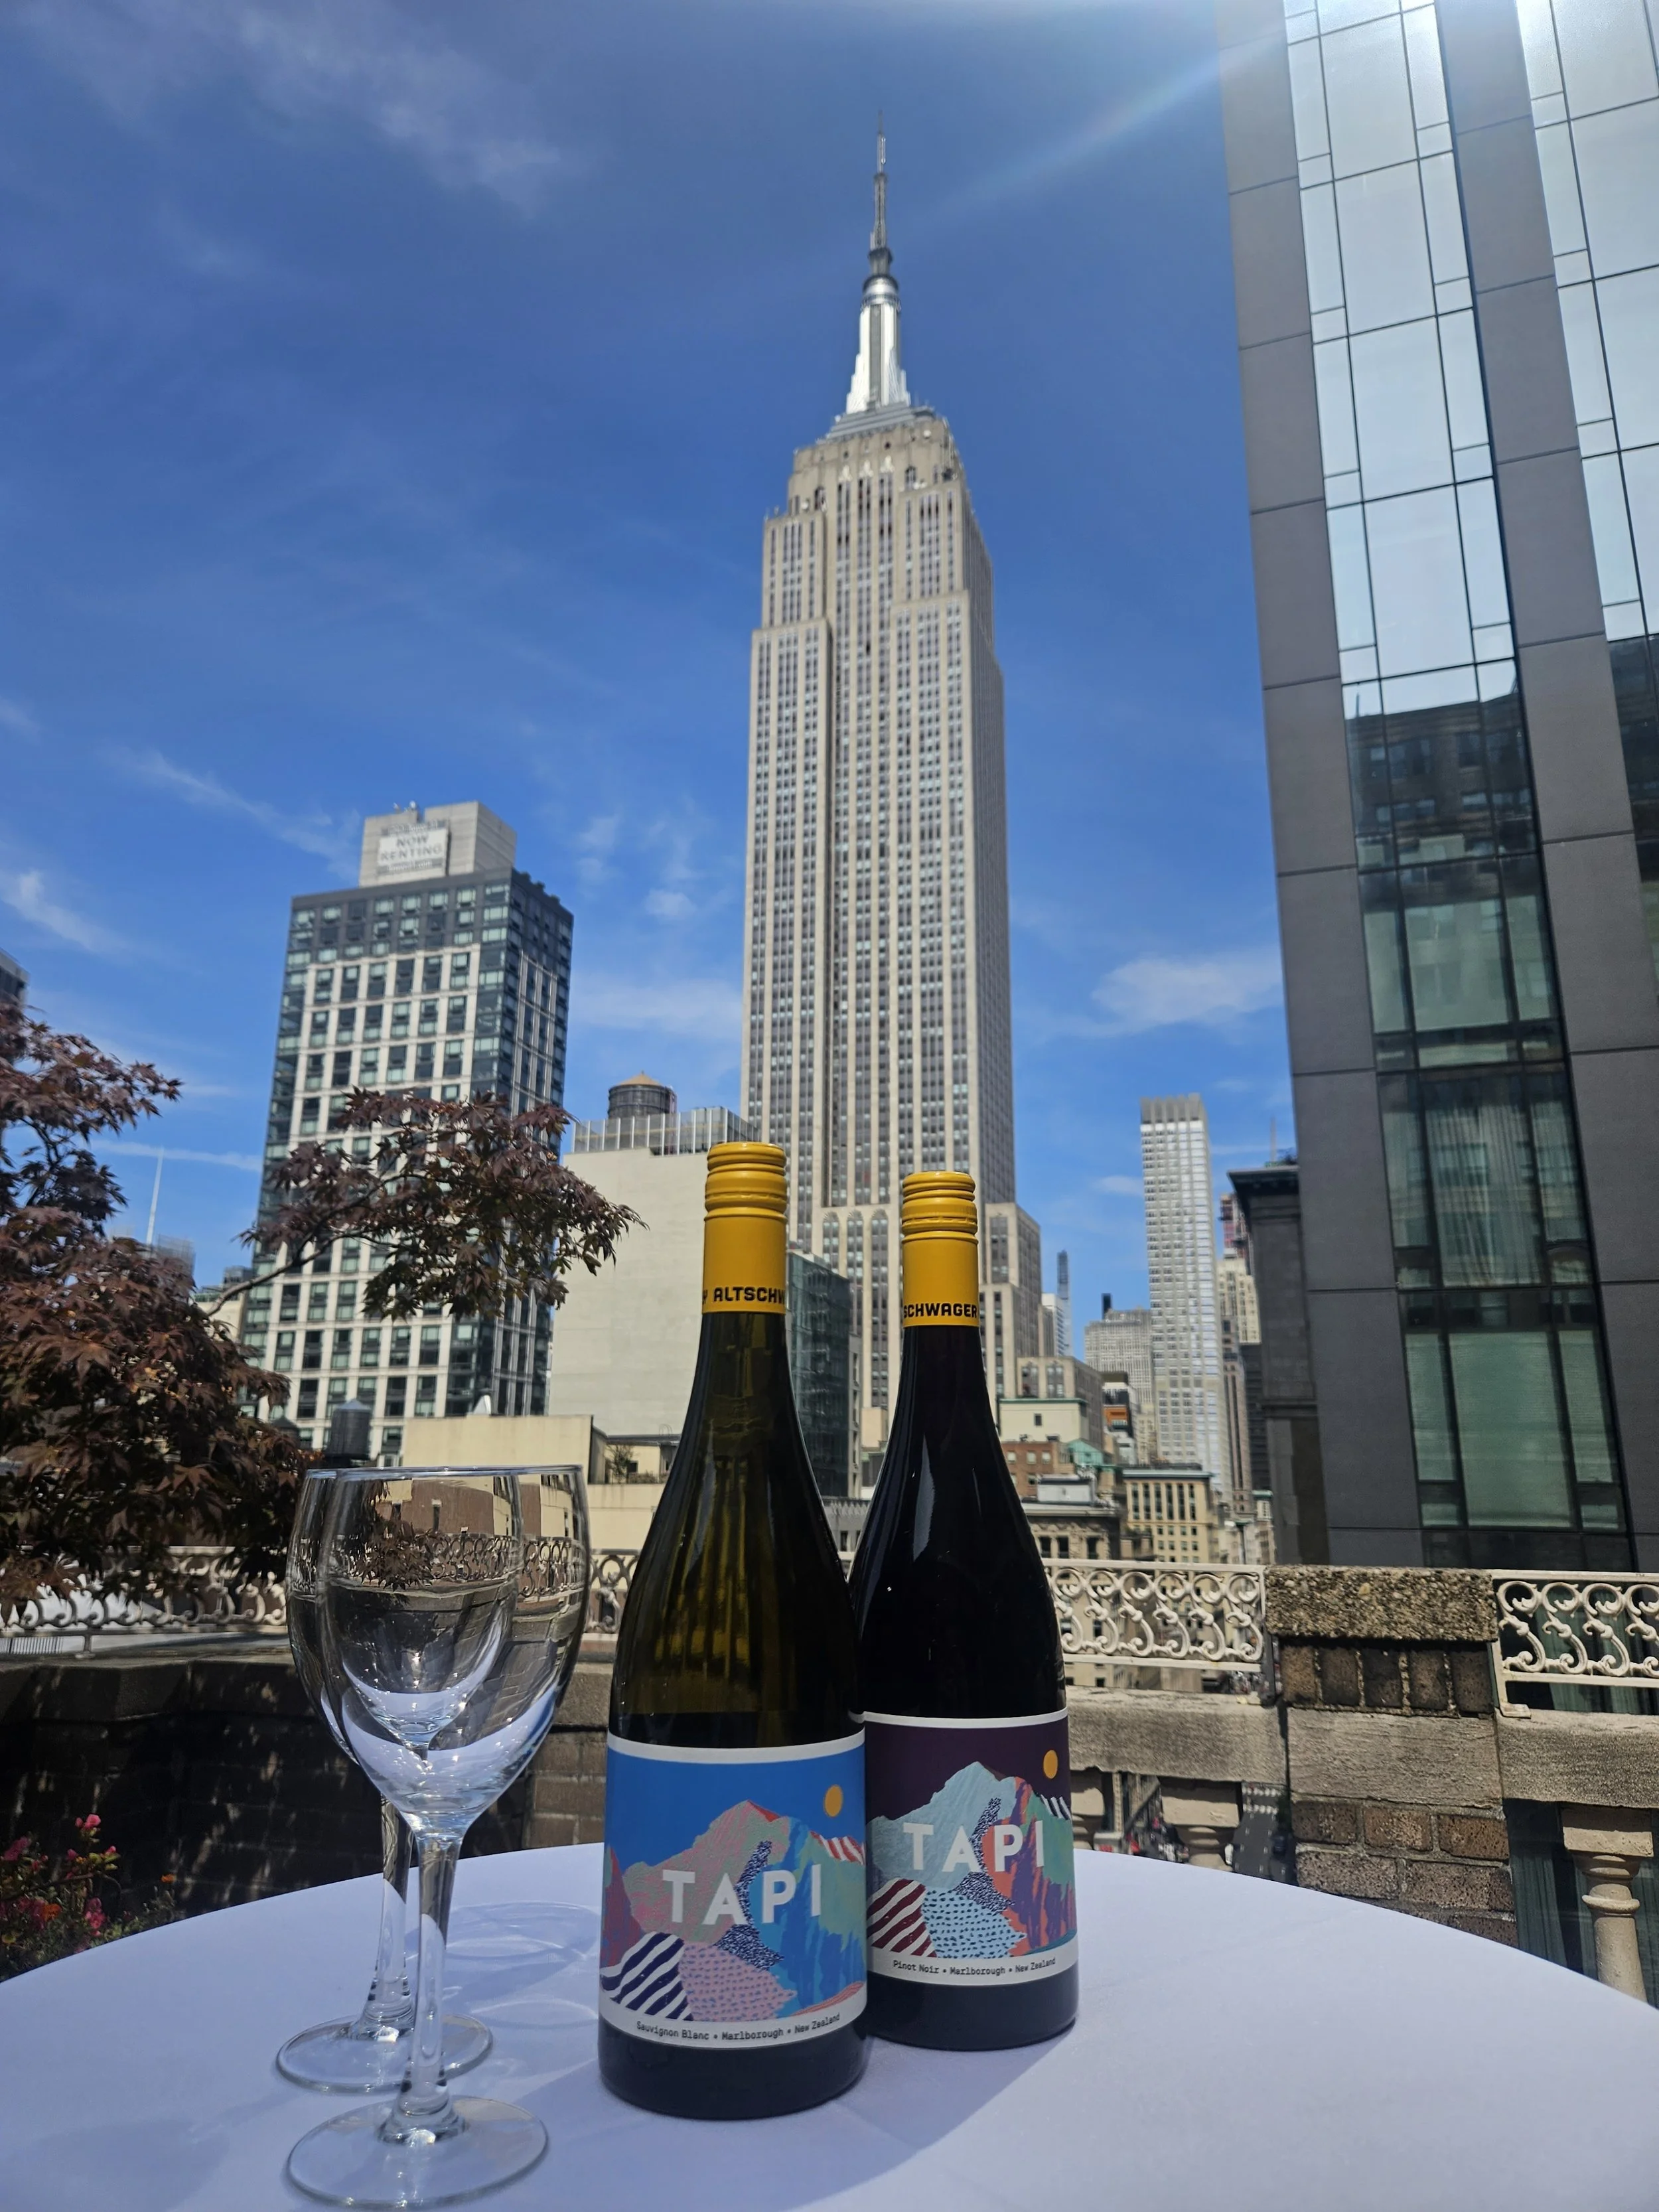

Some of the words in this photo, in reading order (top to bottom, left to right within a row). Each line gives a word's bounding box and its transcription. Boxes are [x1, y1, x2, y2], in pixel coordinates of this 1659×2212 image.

[903, 1302, 977, 1319] SCHWAGER
[903, 1820, 1045, 1873] TAPI
[662, 1864, 822, 1925] TAPI
[893, 1960, 916, 1972] Pinot
[918, 1963, 940, 1974] Noir
[950, 1966, 1006, 1976] Marlborough
[1015, 1964, 1029, 1973] New
[1030, 1957, 1056, 1970] Zealand
[636, 2021, 679, 2037] Sauvignon
[682, 2029, 709, 2040] Blanc
[721, 2028, 784, 2040] Marlborough
[794, 2024, 810, 2033] New
[812, 2013, 841, 2029] Zealand
